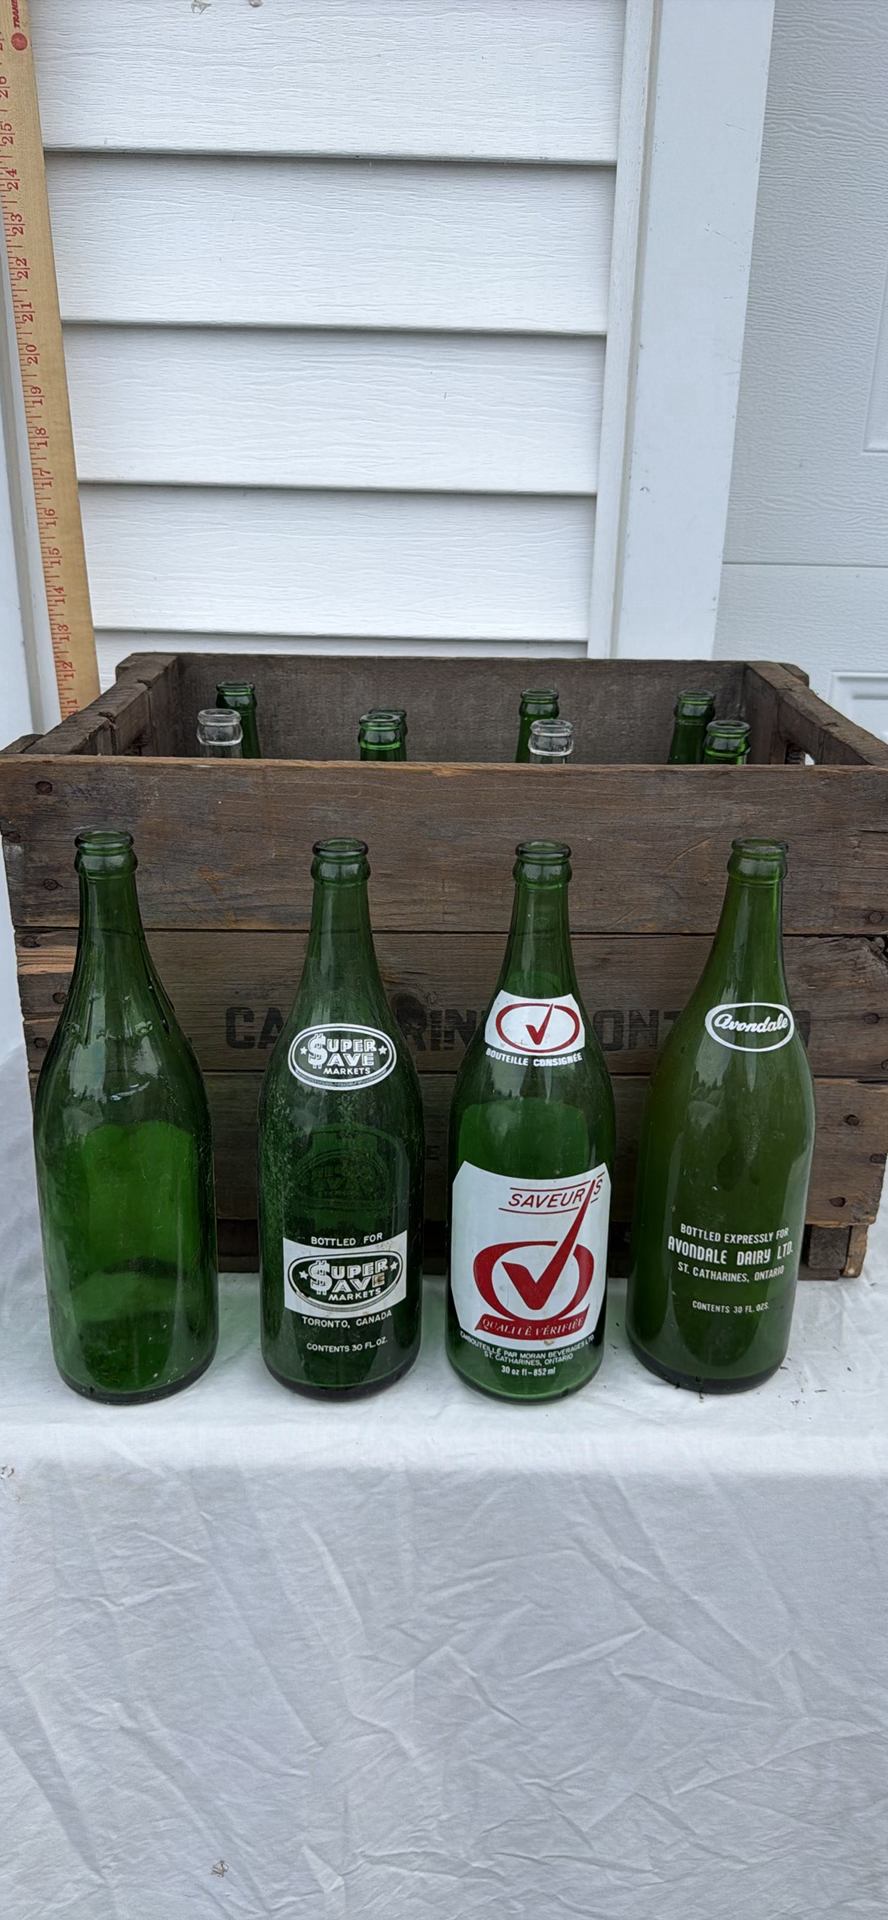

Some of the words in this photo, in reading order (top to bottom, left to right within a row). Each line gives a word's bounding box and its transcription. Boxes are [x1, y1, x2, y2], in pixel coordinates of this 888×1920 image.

[1, 122, 14, 145] 25
[6, 168, 19, 191] 24
[11, 213, 24, 235] 23
[15, 258, 29, 279] 22
[20, 302, 34, 322] 21
[25, 344, 39, 365] 20
[30, 386, 44, 406] 19
[35, 427, 48, 447] 18
[40, 468, 52, 487] 17
[44, 508, 57, 527] 16
[49, 547, 61, 566] 15
[53, 586, 66, 604] 14
[58, 624, 70, 642] 13
[62, 661, 74, 679] 12
[714, 1013, 789, 1033] Avondale
[485, 1048, 529, 1066] BOUTEILLE
[533, 1052, 583, 1067] CONSIGNÉE
[323, 1067, 371, 1075] MARKETS
[310, 1236, 356, 1247] BOTTLED
[363, 1232, 383, 1244] FOR
[680, 1223, 721, 1242] BOTTLED
[724, 1232, 774, 1244] EXPRESSLY
[775, 1227, 789, 1240] FOR
[667, 1236, 728, 1265] AVONDALE
[736, 1248, 771, 1266] DAIRY
[677, 1261, 690, 1274] ST.
[692, 1266, 750, 1283] CATHARINES,
[754, 1265, 785, 1281] ONTARIO
[328, 1287, 382, 1302] MARKETS
[692, 1300, 731, 1314] CONTENTS
[733, 1305, 743, 1314] 30
[302, 1316, 351, 1328] TORONTO,
[355, 1309, 392, 1327] CANADA
[306, 1342, 350, 1353] CONTENTS
[351, 1343, 363, 1352] 30
[503, 1350, 518, 1358] PAR
[519, 1352, 546, 1360] MORAN
[547, 1341, 585, 1359] BEVERAGES
[544, 1353, 574, 1366] ONTARIO
[501, 1364, 511, 1375] 30
[511, 1368, 520, 1376] oz
